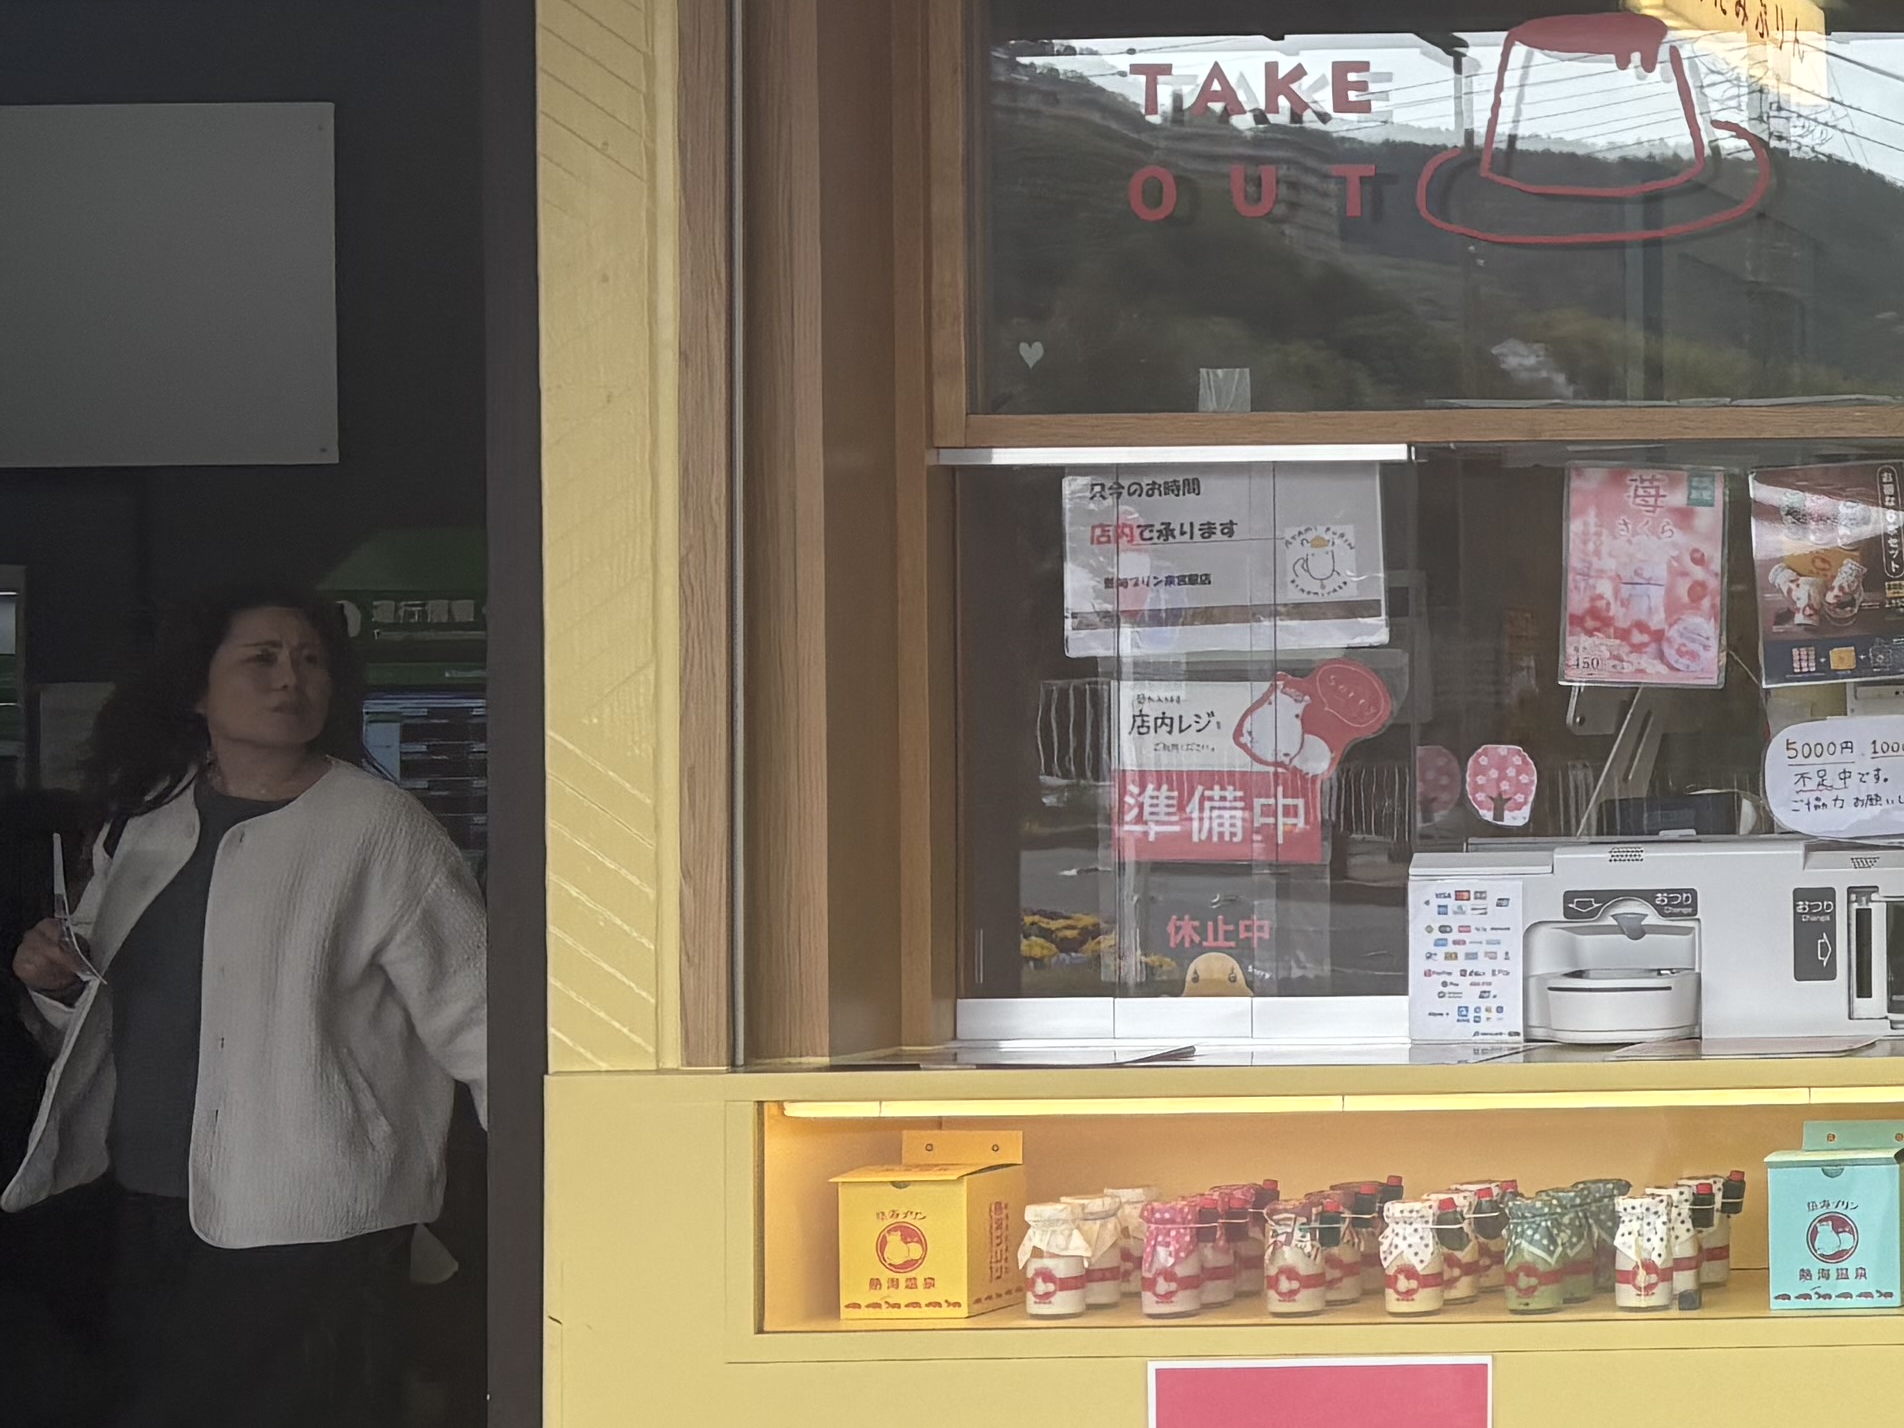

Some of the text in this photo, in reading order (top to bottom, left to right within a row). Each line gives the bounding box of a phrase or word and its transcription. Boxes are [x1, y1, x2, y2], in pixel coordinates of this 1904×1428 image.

[1128, 60, 1374, 118] TAKE
[1127, 161, 1378, 223] OUT
[1089, 477, 1201, 500] 只今のお時間
[1090, 519, 1238, 546] 店内で承ります
[1616, 518, 1676, 540] さくら
[1122, 783, 1306, 845] 準備中
[1655, 892, 1692, 906] おつり
[1796, 900, 1834, 914] おつり
[1166, 914, 1272, 949] 休止中
